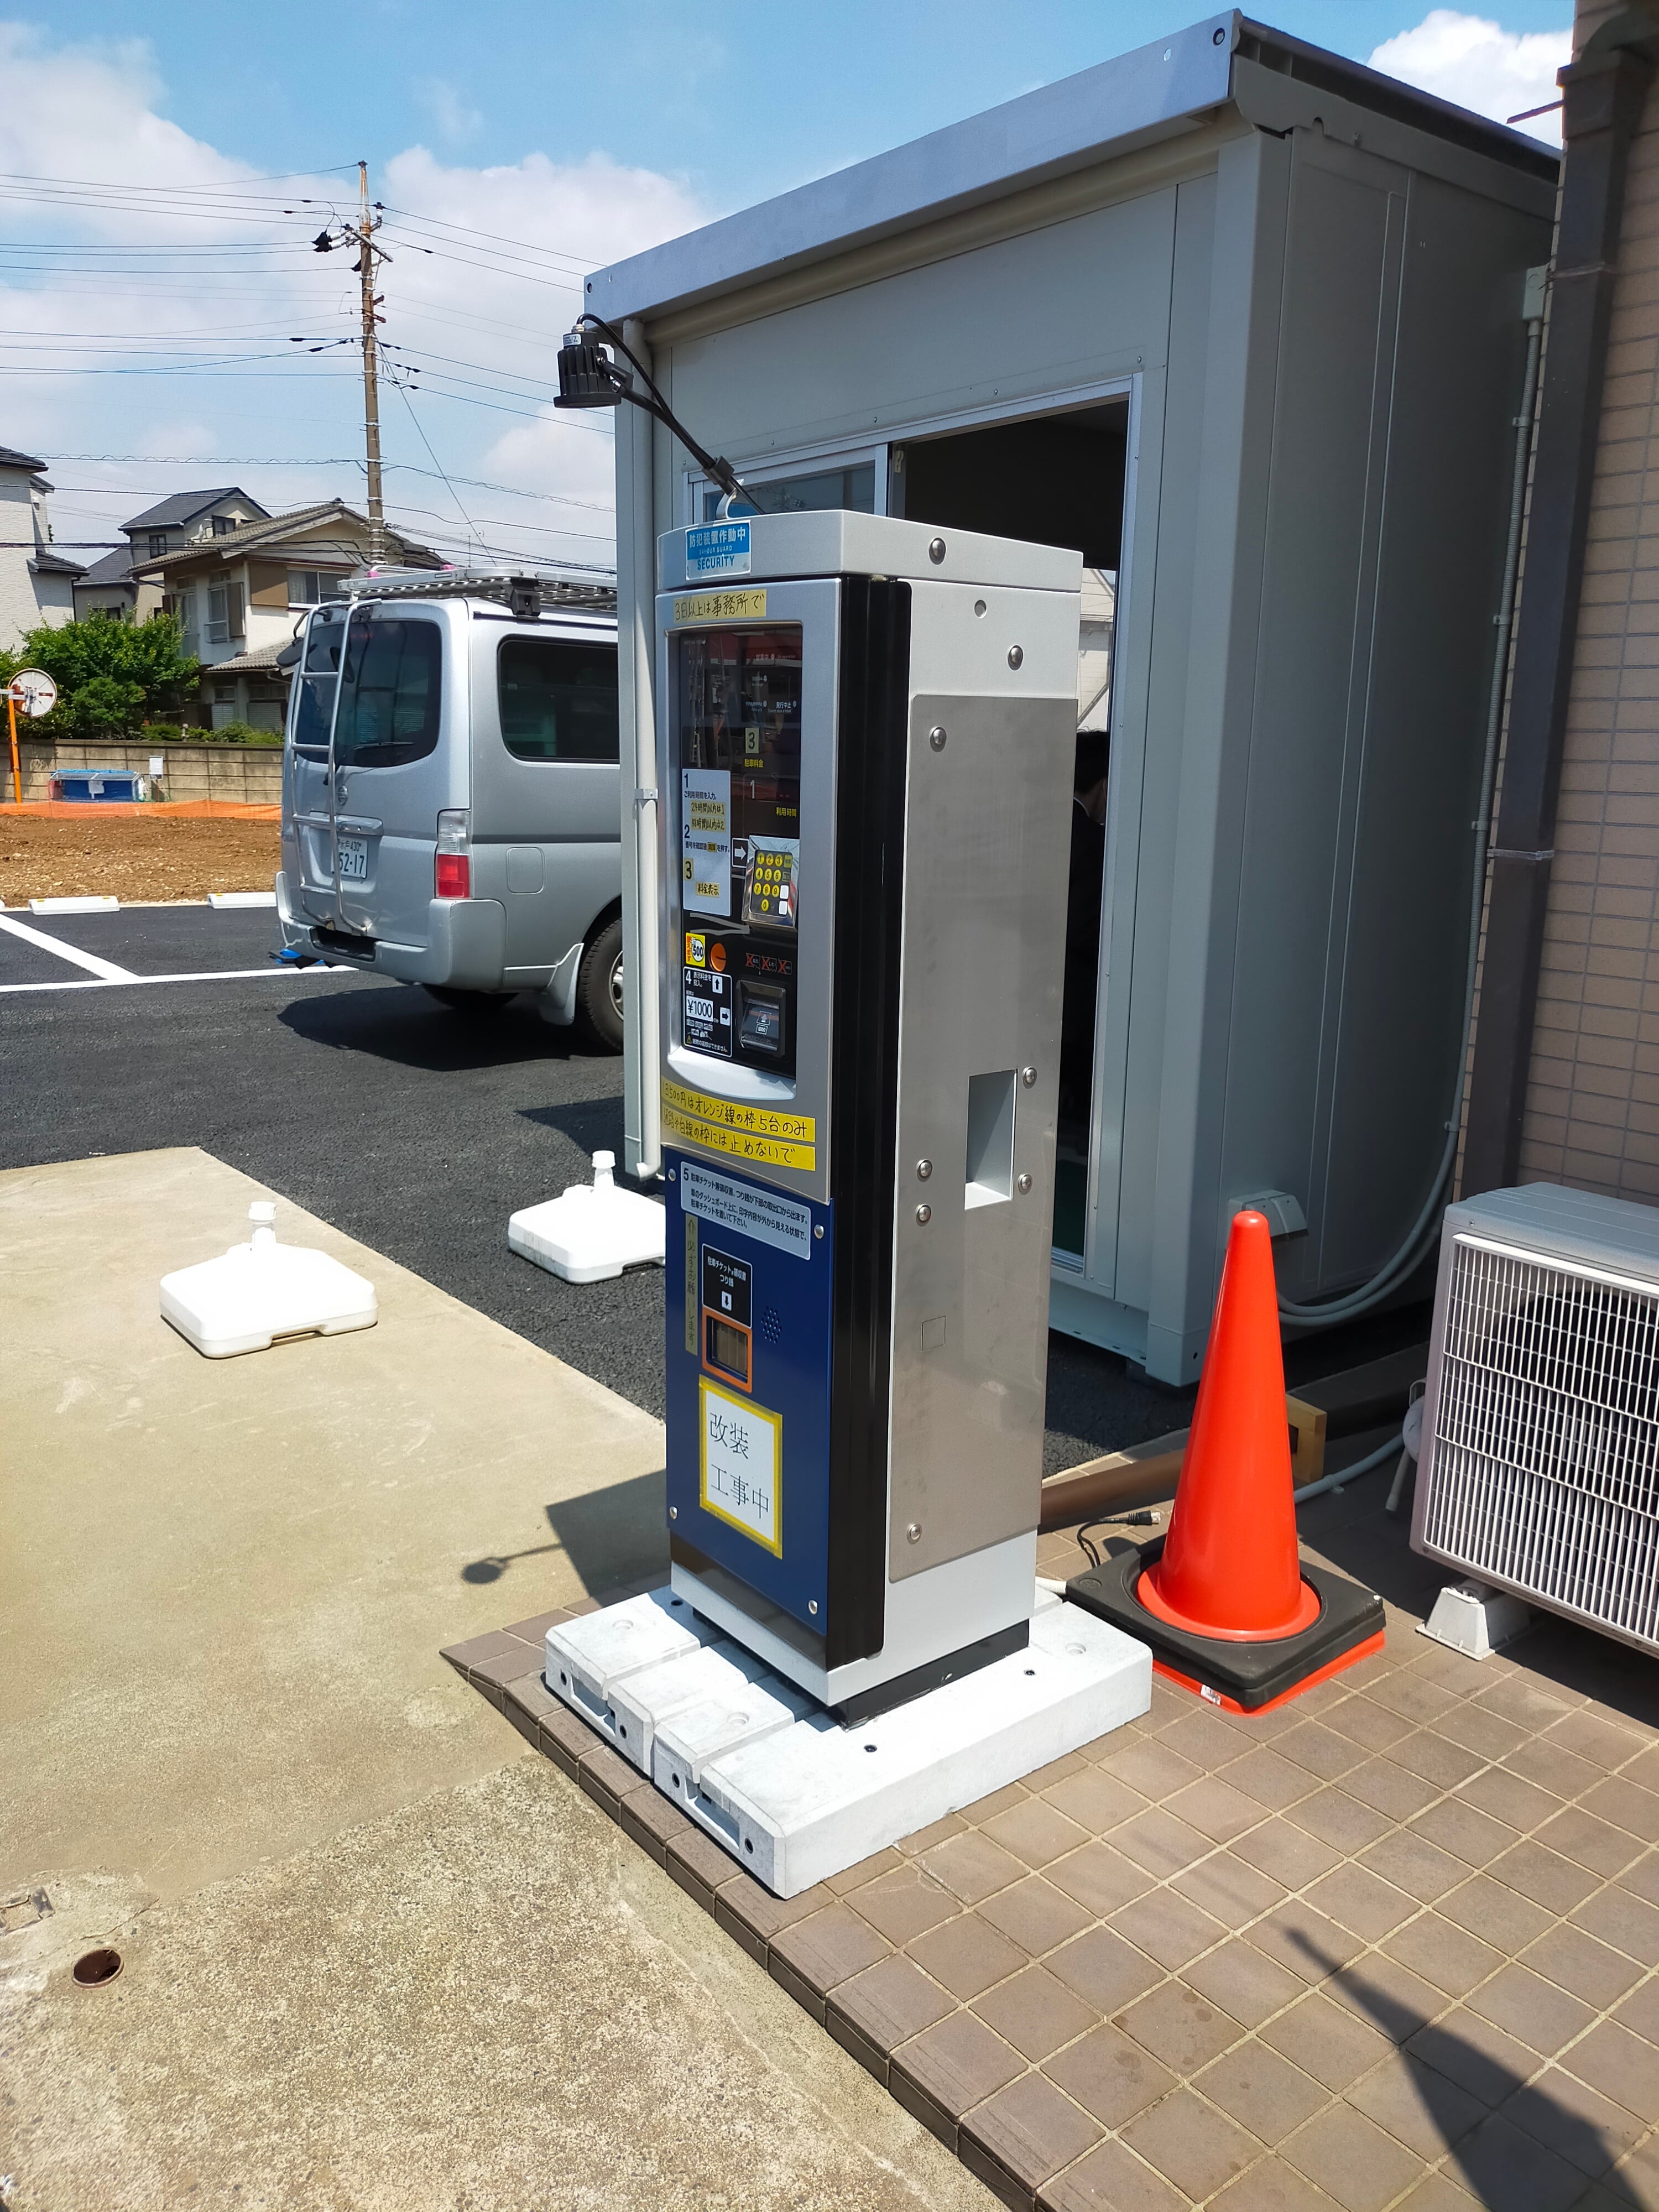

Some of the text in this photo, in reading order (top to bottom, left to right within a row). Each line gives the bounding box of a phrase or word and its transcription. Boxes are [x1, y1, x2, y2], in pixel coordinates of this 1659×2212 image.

[689, 527, 745, 549] 防犯装置作動中
[697, 555, 734, 570] SECURITY
[675, 593, 764, 620] 3日以上は事務所で
[748, 732, 755, 749] 3
[744, 759, 764, 768] 駐車料金
[684, 773, 688, 787] 1
[750, 780, 755, 799] 1
[776, 807, 797, 817] 利用時間
[685, 825, 690, 838] 2
[686, 861, 692, 879] 3
[693, 946, 703, 957] 500
[686, 971, 712, 984] 4 表示料金を
[687, 999, 712, 1018] ¥1000
[684, 1167, 689, 1181] 5
[710, 1412, 749, 1459] 改装
[711, 1464, 769, 1519] 工事中
